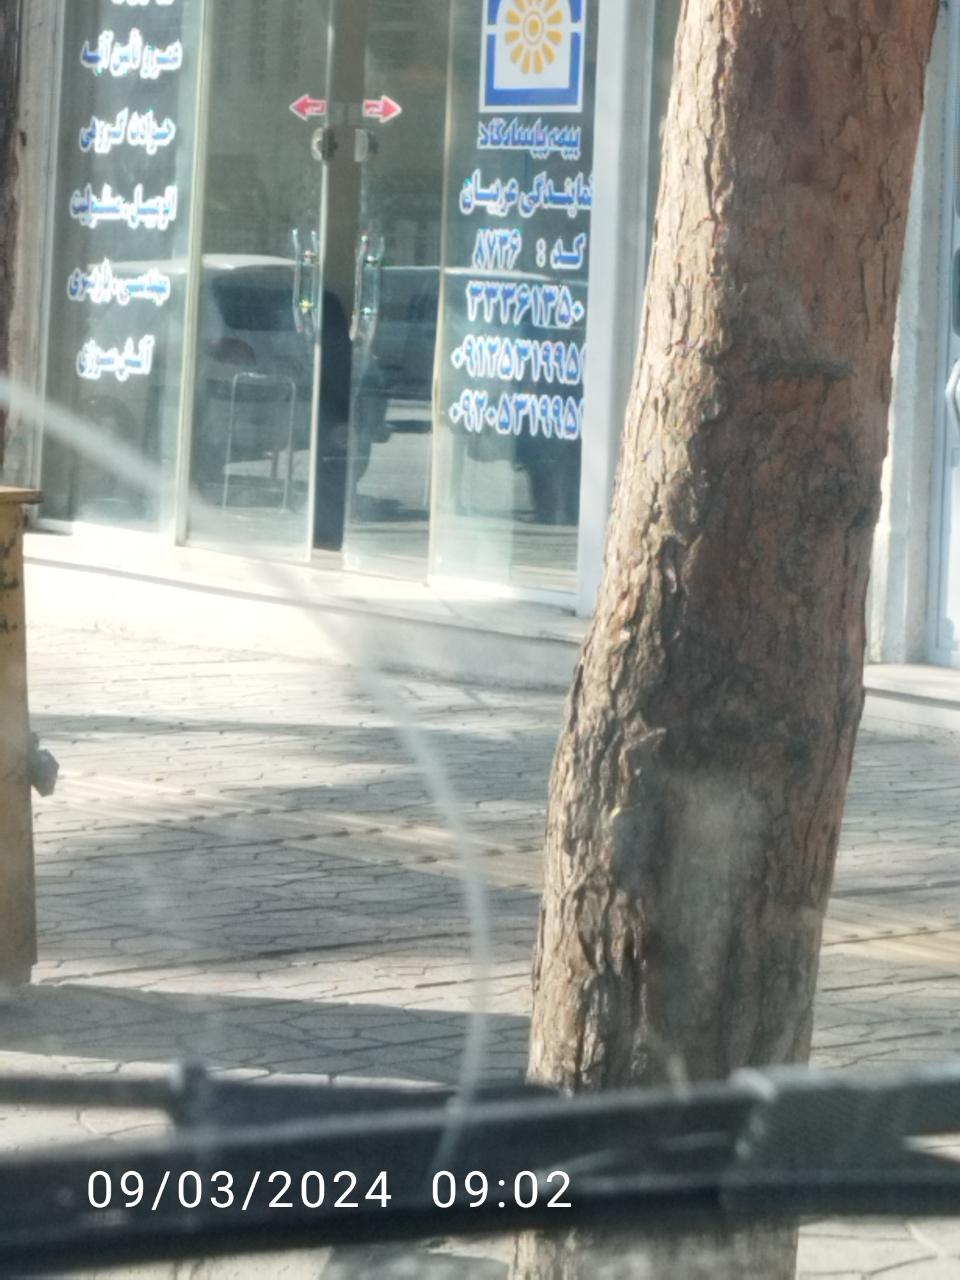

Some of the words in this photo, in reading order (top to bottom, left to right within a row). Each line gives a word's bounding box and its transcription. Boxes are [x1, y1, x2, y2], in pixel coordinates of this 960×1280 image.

[476, 117, 550, 159] پاسارگاد
[544, 124, 582, 161] بیمه
[458, 168, 520, 217] عربیان
[472, 227, 523, 270] ۸۷۳۶
[549, 231, 587, 270] کد
